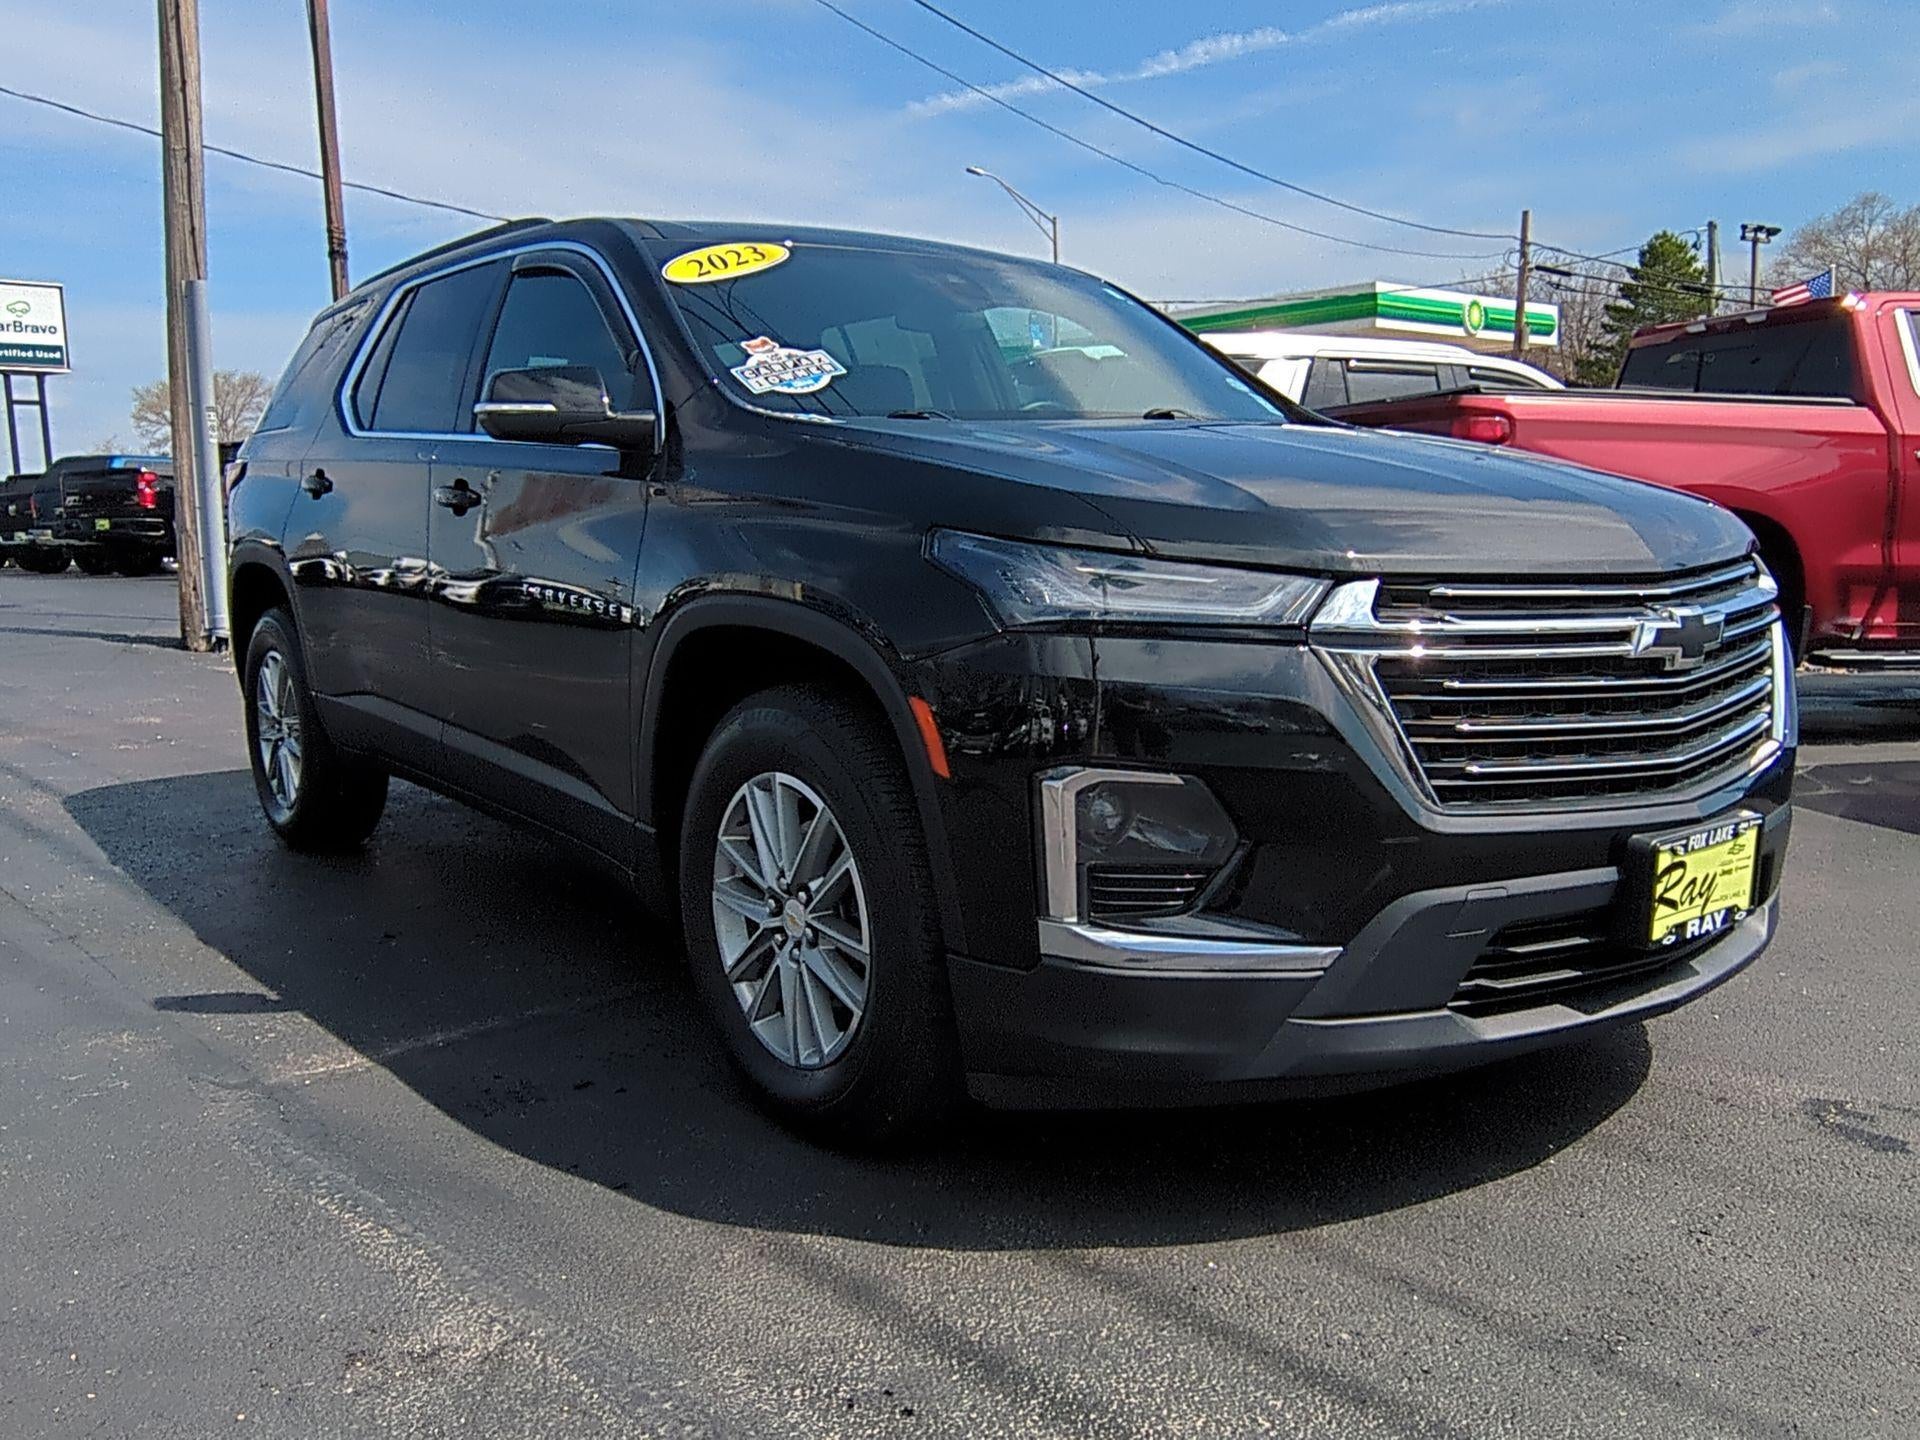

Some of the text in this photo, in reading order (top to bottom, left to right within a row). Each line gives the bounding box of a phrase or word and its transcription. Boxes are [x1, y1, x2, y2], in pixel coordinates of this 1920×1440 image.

[686, 246, 766, 277] 2023
[0, 320, 57, 335] arBravo
[0, 348, 61, 359] rtified Used
[521, 583, 618, 617] TRAVERSE
[1688, 825, 1735, 851] FOX LAKE
[1654, 860, 1719, 916] Ray
[1686, 909, 1727, 939] RAY
